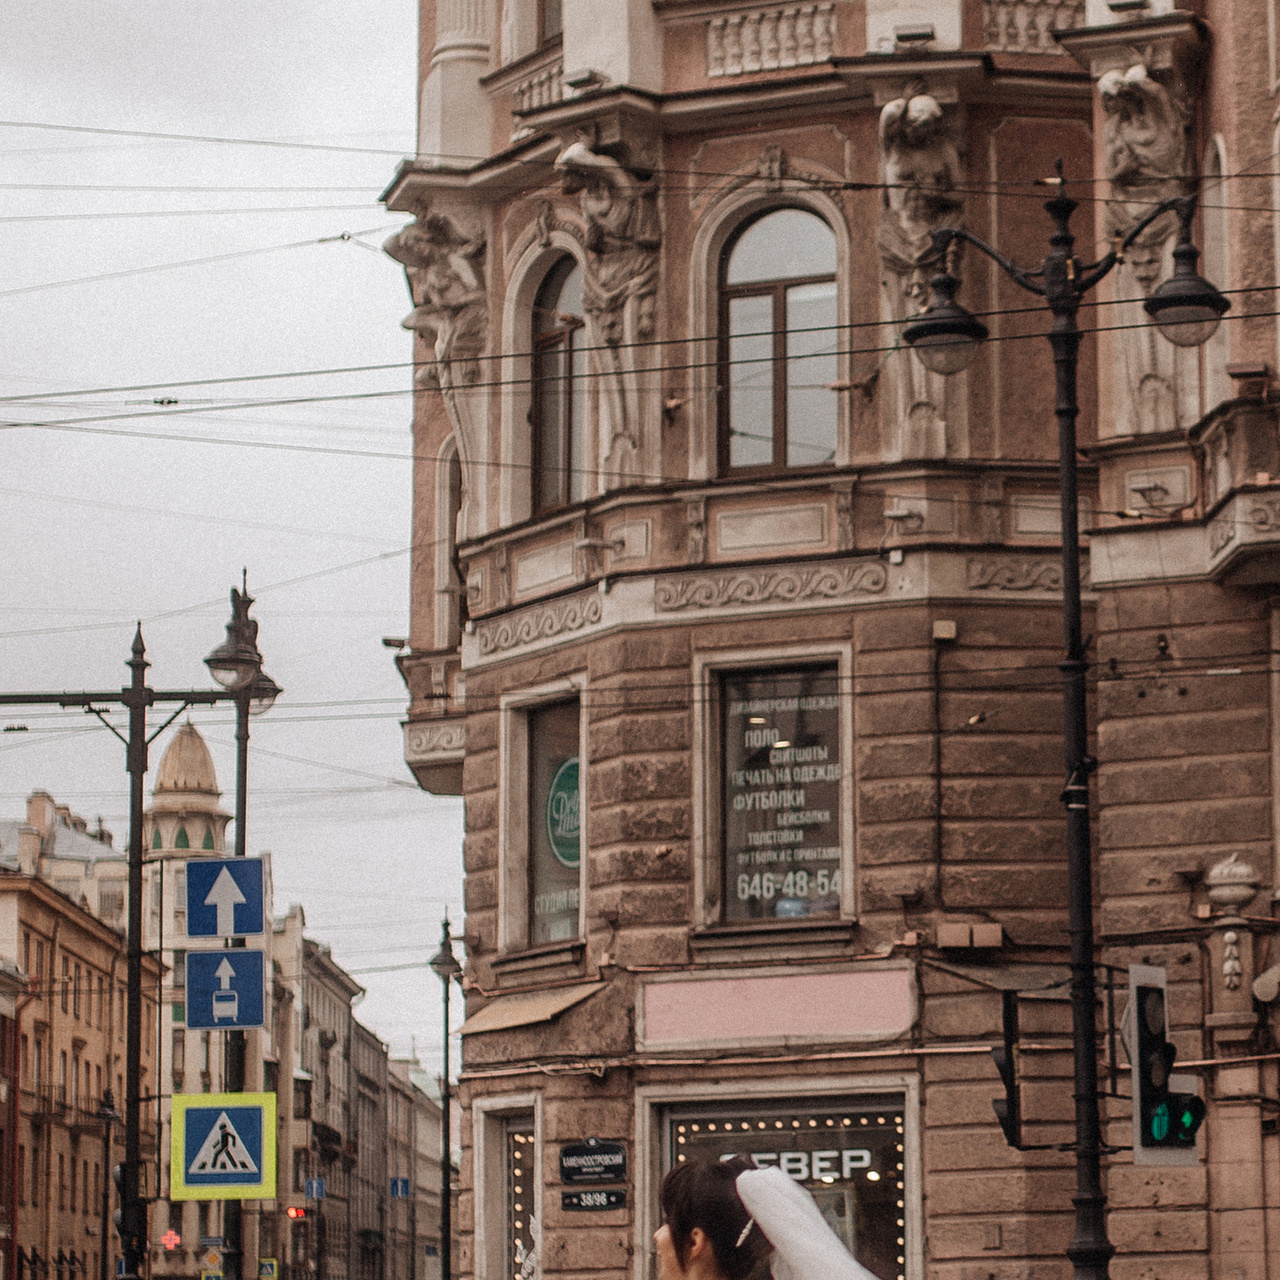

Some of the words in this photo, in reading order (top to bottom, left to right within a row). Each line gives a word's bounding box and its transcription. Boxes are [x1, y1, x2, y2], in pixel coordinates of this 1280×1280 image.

[744, 728, 779, 748] ПОЛО
[732, 768, 775, 786] ПЕЧАТЬ
[775, 767, 792, 783] НА
[733, 790, 805, 811] ФУТБОЛКИ
[777, 810, 831, 826] БЕЙСБОЛКИ
[748, 829, 804, 846] ТОЛСТОВКИ
[737, 868, 842, 901] 646-48-54
[719, 1149, 872, 1181] ЕВЕР
